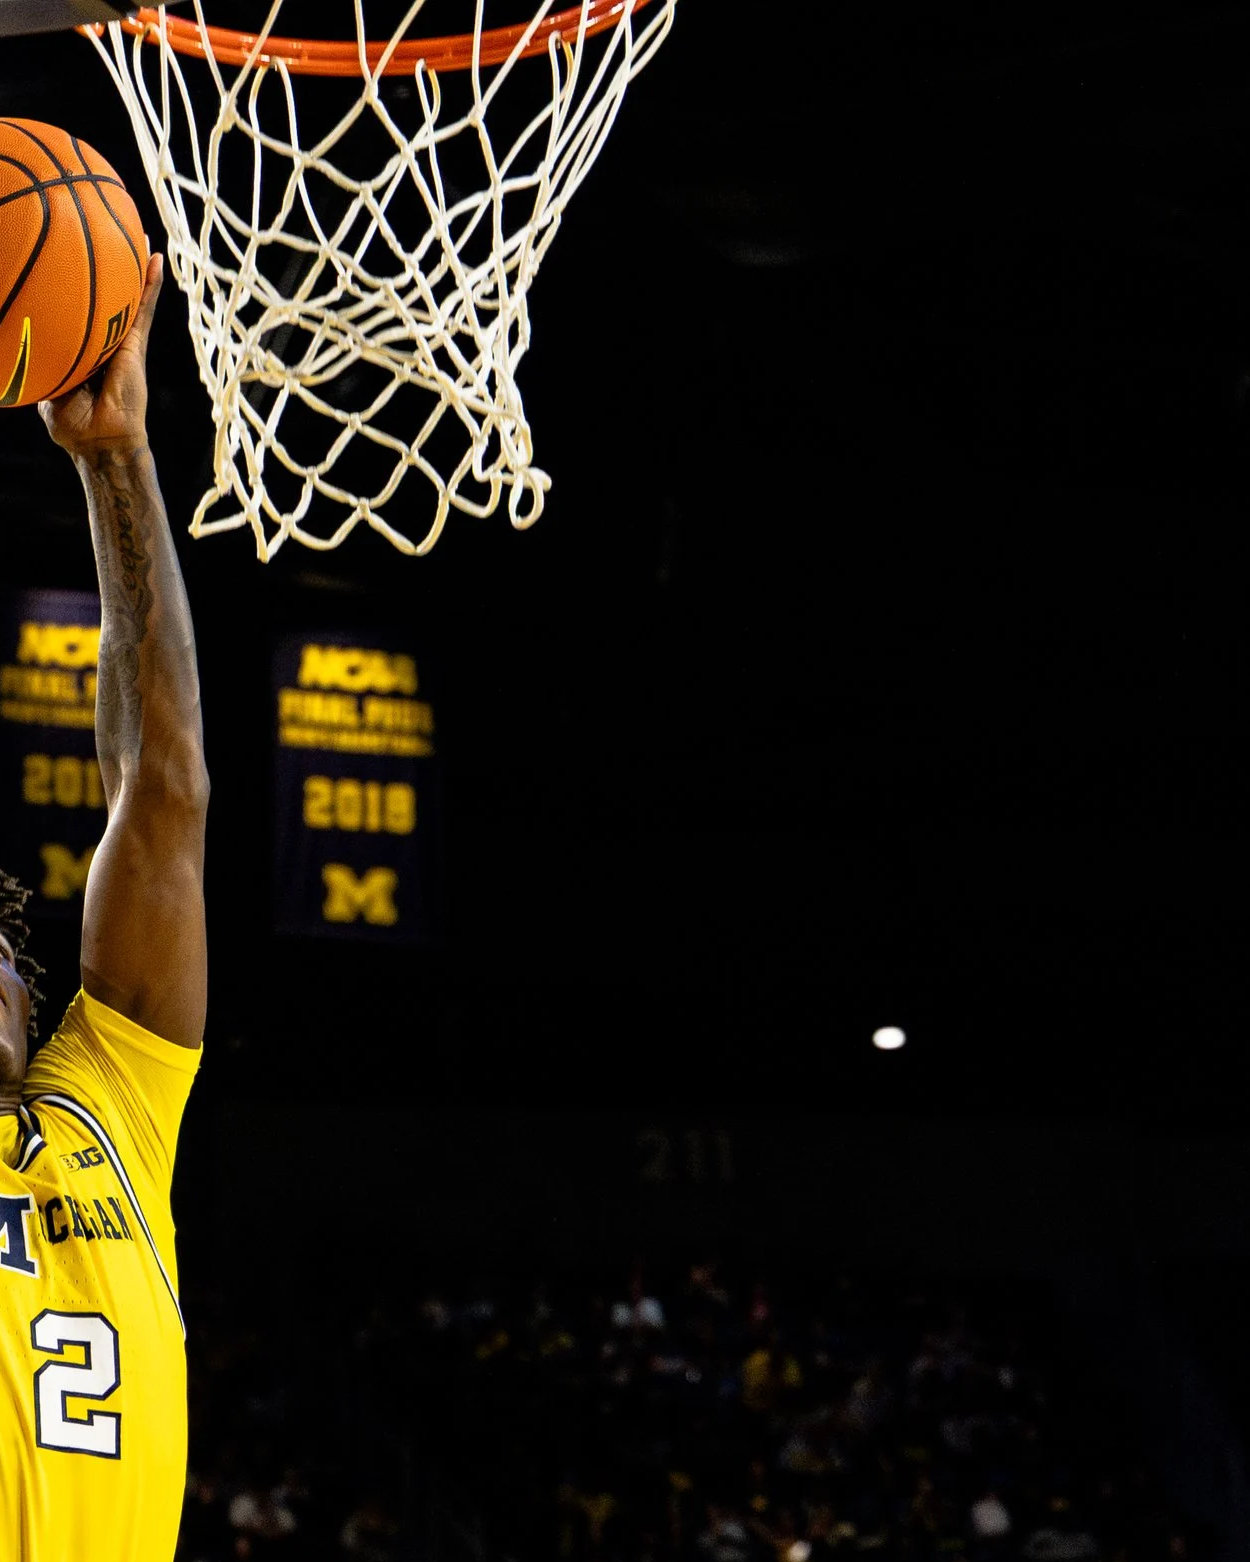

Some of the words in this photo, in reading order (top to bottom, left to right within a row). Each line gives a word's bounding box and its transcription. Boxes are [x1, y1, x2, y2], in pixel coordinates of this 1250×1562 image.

[299, 644, 418, 695] NCAA
[22, 754, 105, 808] 201
[322, 863, 398, 926] M
[637, 1122, 736, 1185] 211
[31, 1308, 121, 1460] 2
